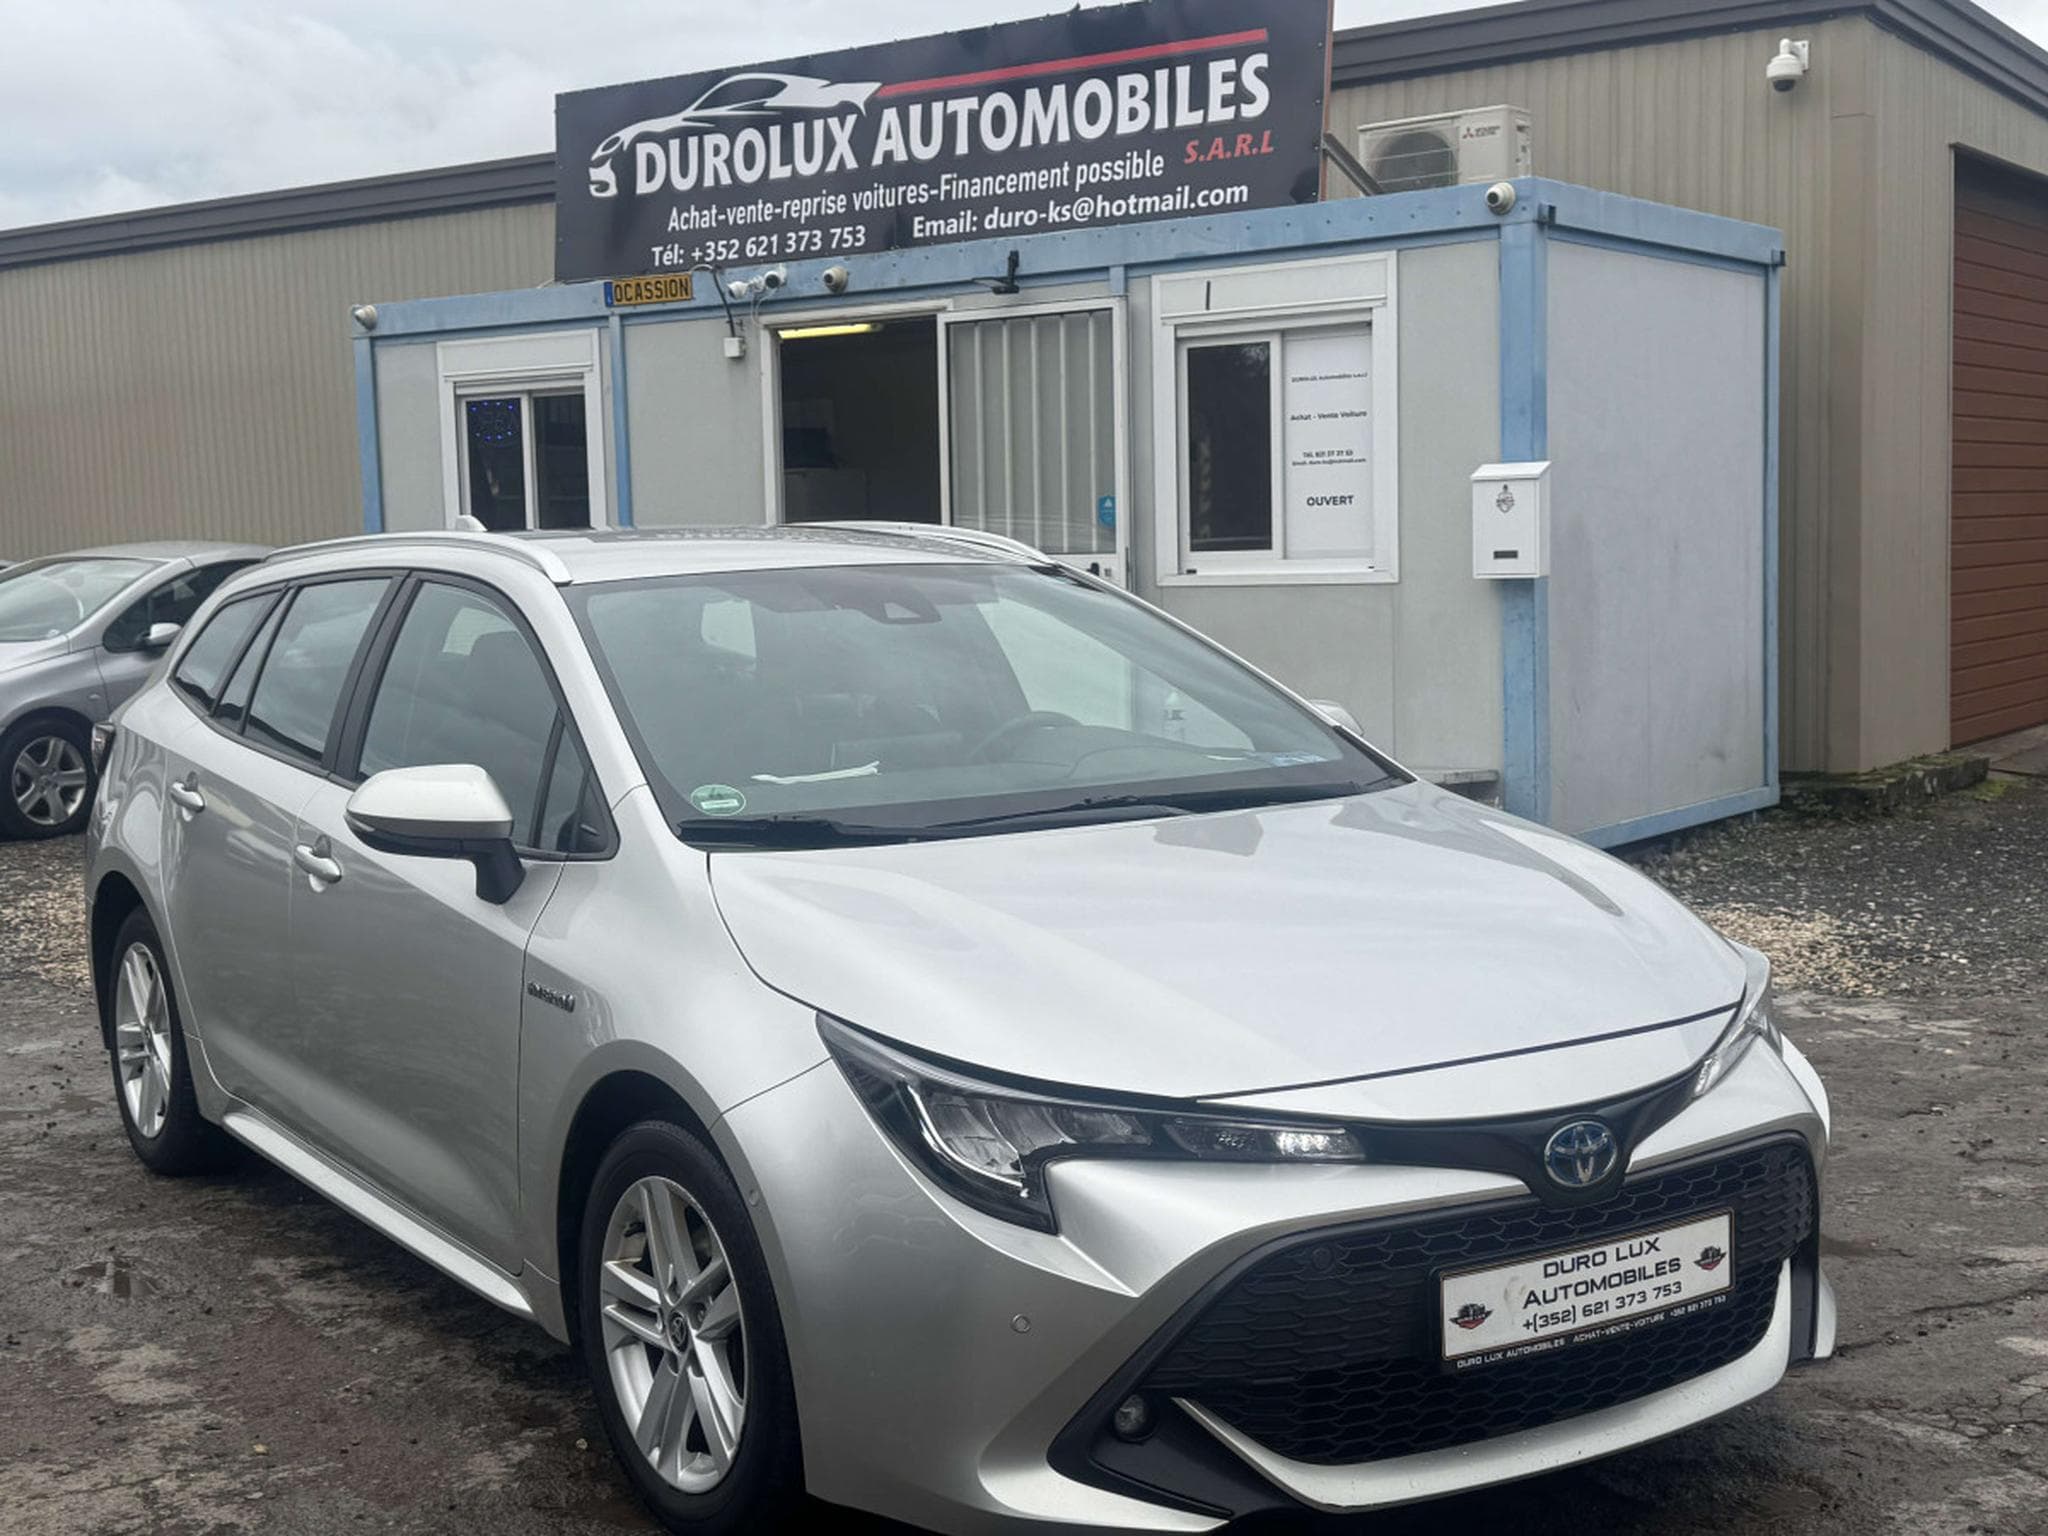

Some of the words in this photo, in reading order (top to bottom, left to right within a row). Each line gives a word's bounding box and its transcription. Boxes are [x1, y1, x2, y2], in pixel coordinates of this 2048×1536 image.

[636, 114, 859, 195] DUROLUX
[871, 53, 1271, 166] AUTOMOBILES
[1184, 130, 1274, 164] S.A.R.L
[667, 191, 848, 232] Achat-vente-reprise
[852, 161, 1070, 209] voitures-Financement
[1075, 149, 1165, 193] possible
[913, 212, 979, 238] Email:
[984, 184, 1249, 231] duro-ks@hotmail.com
[652, 238, 685, 267] Tél:
[690, 239, 740, 263] +352
[745, 233, 779, 257] 621
[785, 229, 823, 253] 373
[830, 225, 866, 249] 753
[614, 278, 689, 302] OCASSION
[1306, 494, 1354, 507] OUVERT
[1543, 1250, 1607, 1279] DURO
[1615, 1237, 1661, 1262] LUX
[1523, 1257, 1682, 1309] AUTOMOBILES
[1523, 1304, 1576, 1333] +(352)
[1582, 1300, 1609, 1317] 621
[1615, 1290, 1647, 1310] 373
[1652, 1280, 1682, 1299] 753
[1456, 1356, 1482, 1369] DURO
[1484, 1350, 1503, 1363] LUX
[1506, 1338, 1565, 1358] AUTOMOBILES
